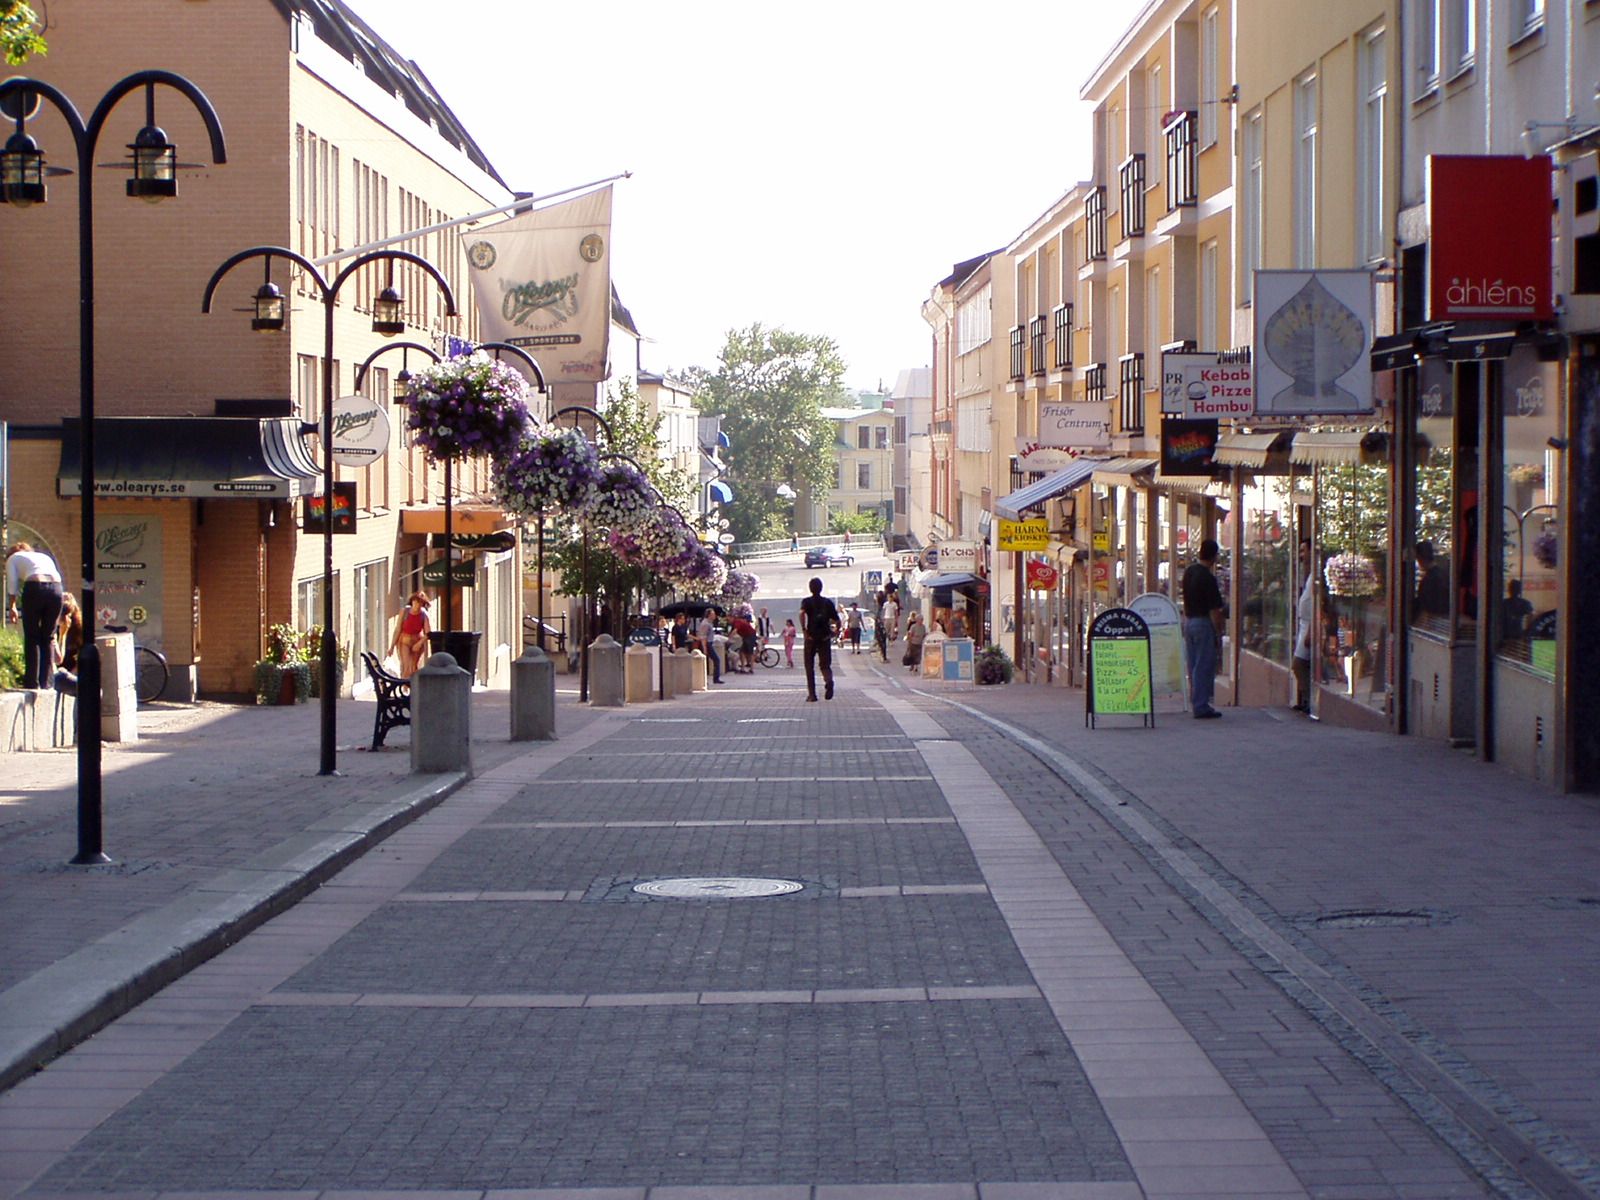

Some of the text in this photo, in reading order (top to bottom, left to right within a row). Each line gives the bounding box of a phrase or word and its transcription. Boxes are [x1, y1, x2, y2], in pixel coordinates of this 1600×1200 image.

[1446, 278, 1536, 304] åhléns
[1200, 369, 1250, 382] Kebab
[1211, 384, 1252, 397] Pizze
[1042, 406, 1075, 418] Frisör
[1194, 400, 1252, 413] Hambu
[1056, 418, 1102, 429] Centrum
[1103, 625, 1134, 636] Öppet
